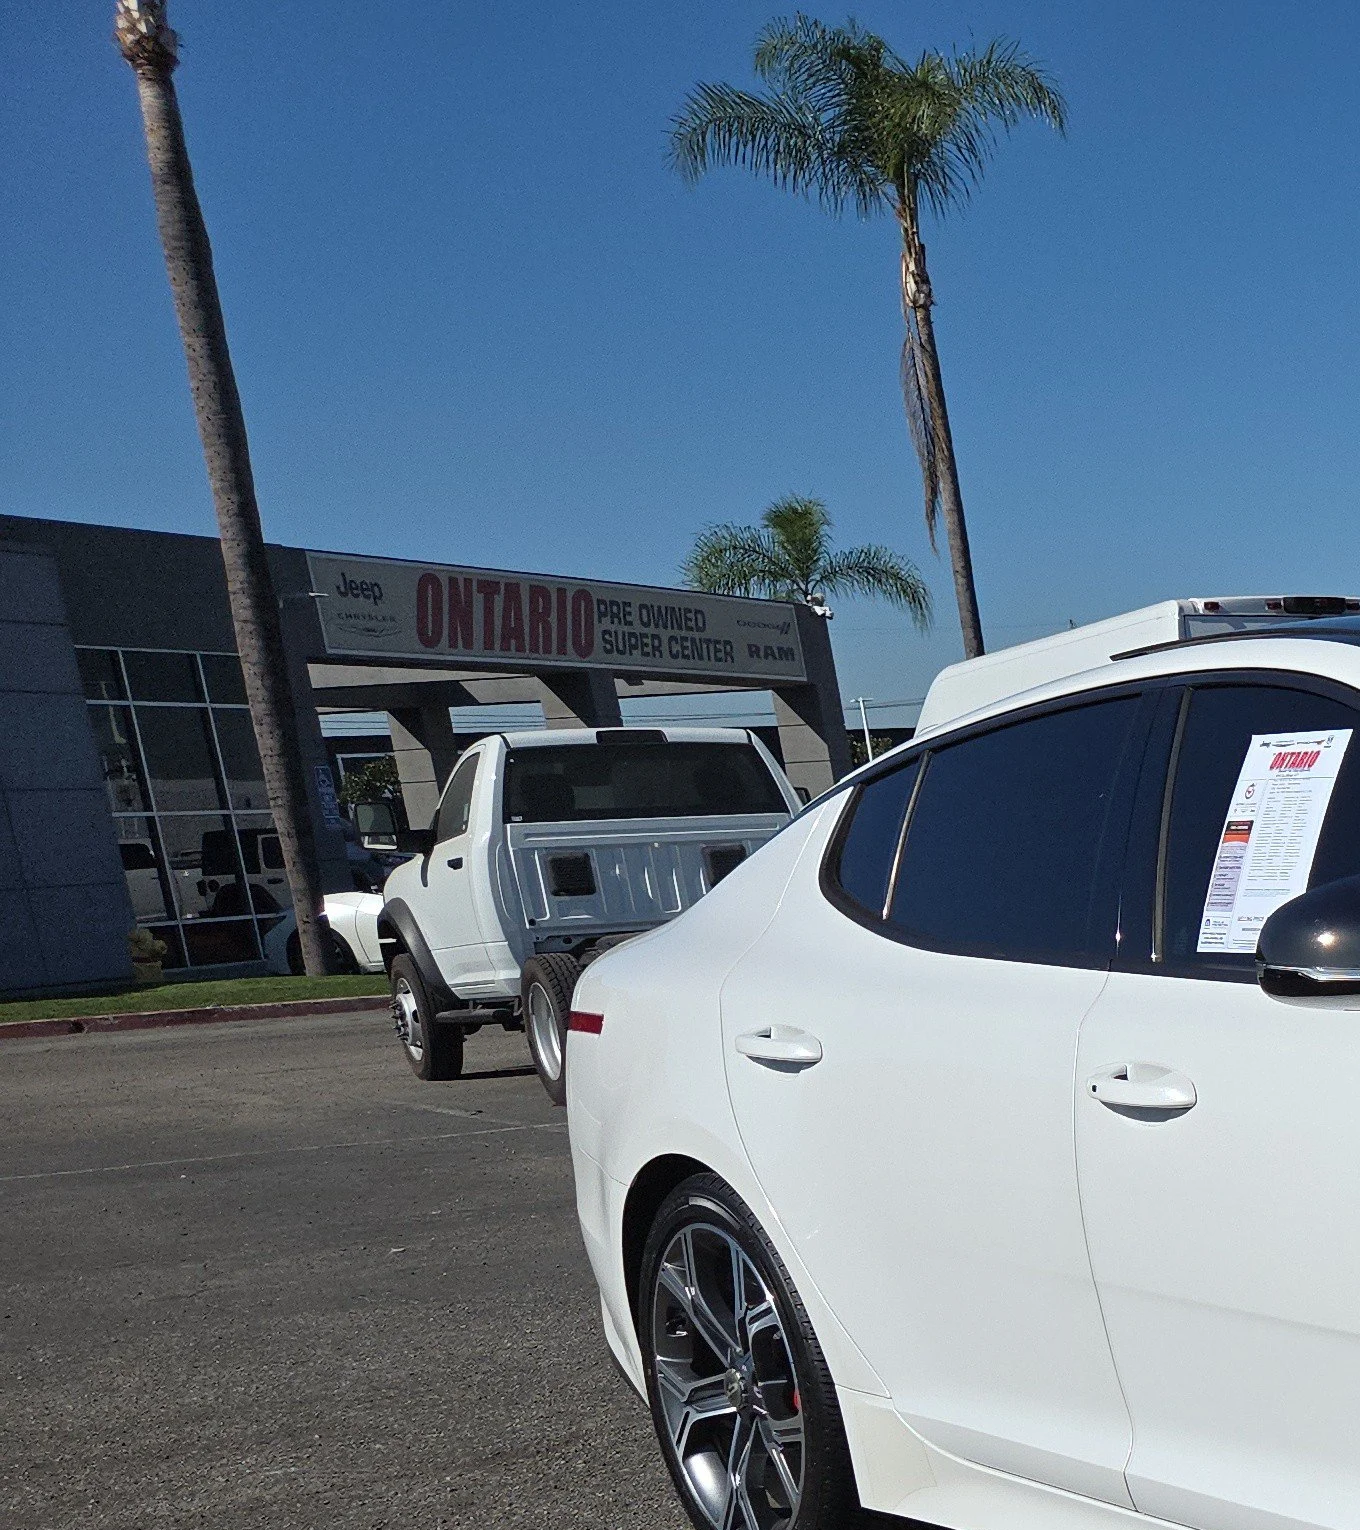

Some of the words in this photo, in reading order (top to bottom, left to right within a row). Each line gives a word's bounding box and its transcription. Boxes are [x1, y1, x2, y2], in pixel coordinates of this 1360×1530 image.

[335, 572, 383, 606] Jeep
[416, 572, 595, 659] ONTARIO
[596, 598, 634, 626] PRE
[638, 603, 707, 633] OWNED
[602, 629, 664, 659] SUPER
[667, 635, 735, 664] CENTER
[747, 644, 795, 661] RAM
[1269, 750, 1321, 770] ONTARIO
